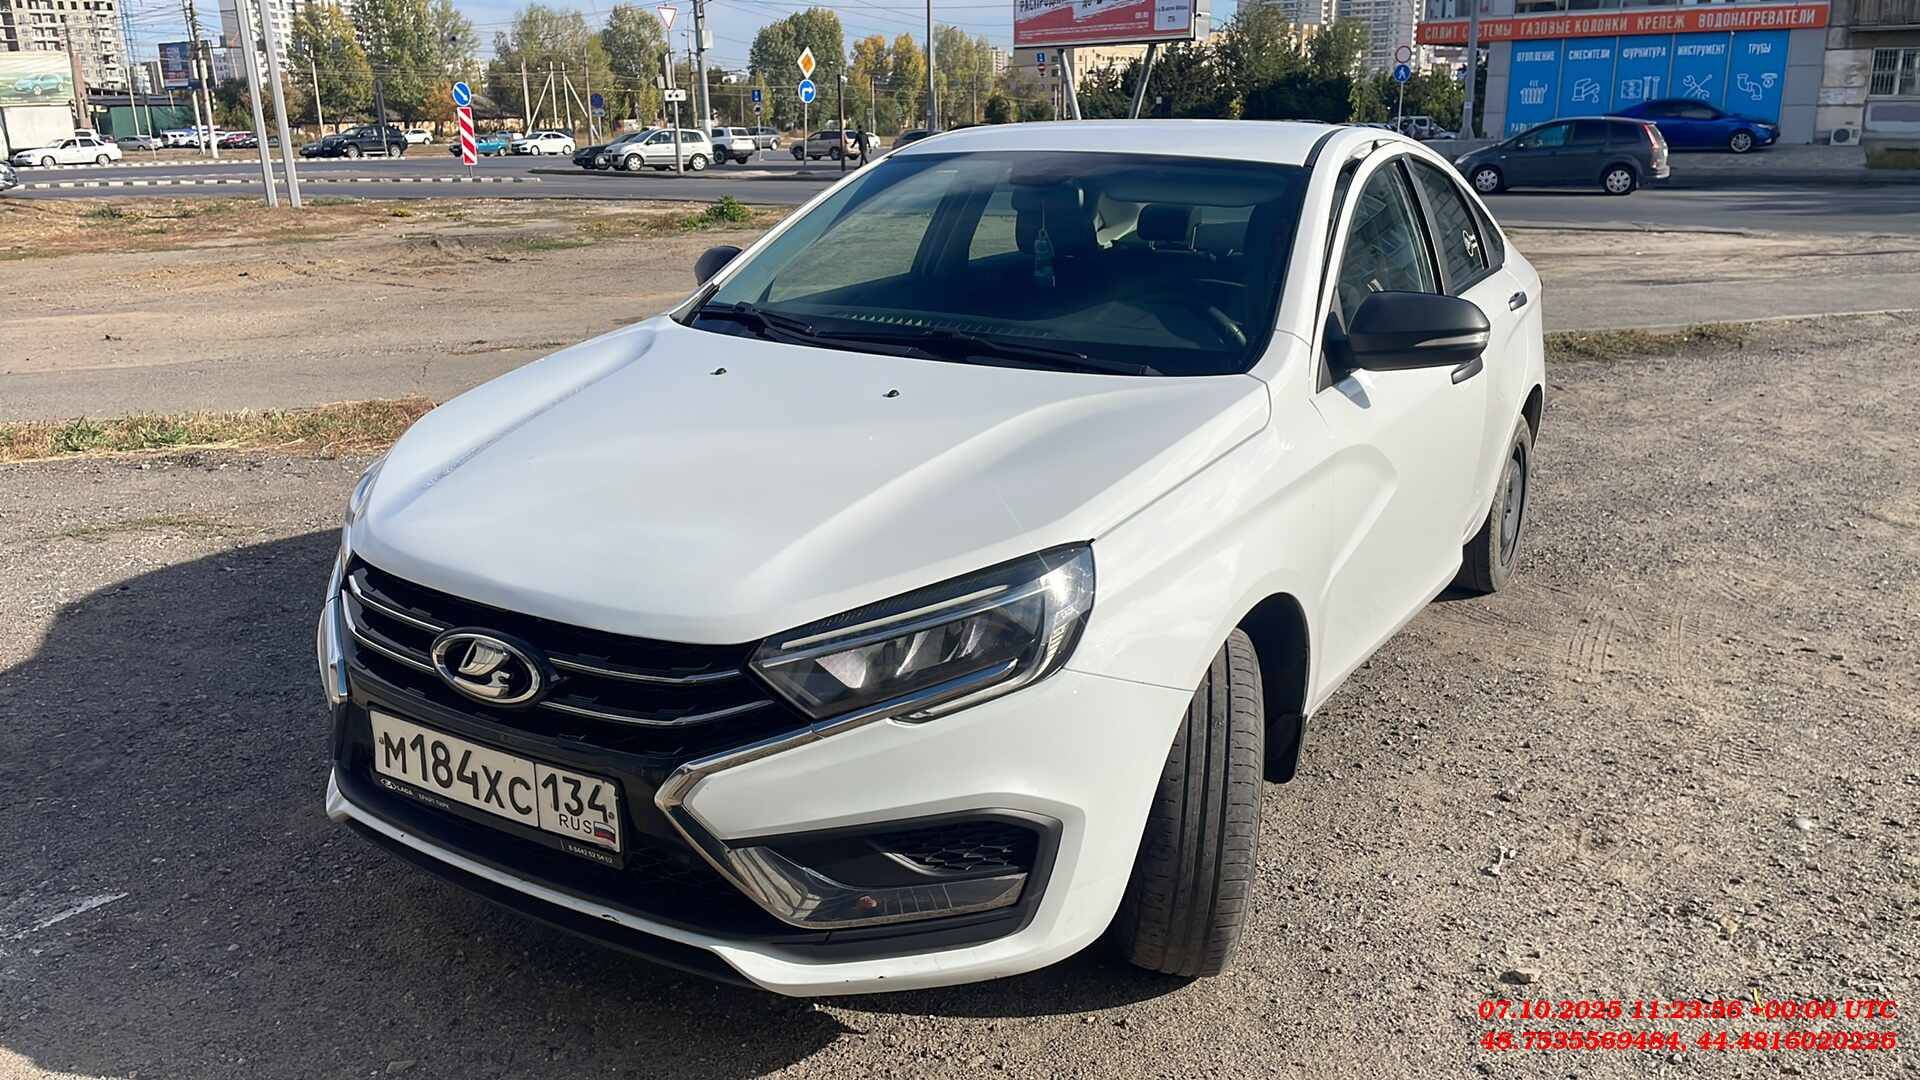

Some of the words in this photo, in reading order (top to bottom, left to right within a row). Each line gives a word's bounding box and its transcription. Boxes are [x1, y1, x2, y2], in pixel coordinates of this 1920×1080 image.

[1424, 26, 1457, 40] СПЛИТ
[1462, 23, 1512, 39] ССТЕМЫ
[1520, 20, 1570, 35] ГАЗОВЫЕ
[1575, 16, 1627, 32] КОЛОНКИ
[1637, 15, 1685, 30] КРЕПЕЖ
[1698, 9, 1816, 28] ВОДОНАГРЕВАТЕЛИ
[1623, 46, 1666, 59] ФУРНИТУРА
[1677, 43, 1726, 56] ИНСТРУМЕНТ
[1748, 42, 1772, 54] ТРУБЫ
[1516, 50, 1555, 62] ОТОПЛЕНИЕ
[1568, 49, 1610, 61] СМЕСИТЕЛИ
[383, 731, 533, 816] М184ХС
[541, 773, 609, 824] 134
[559, 814, 592, 834] RUS
